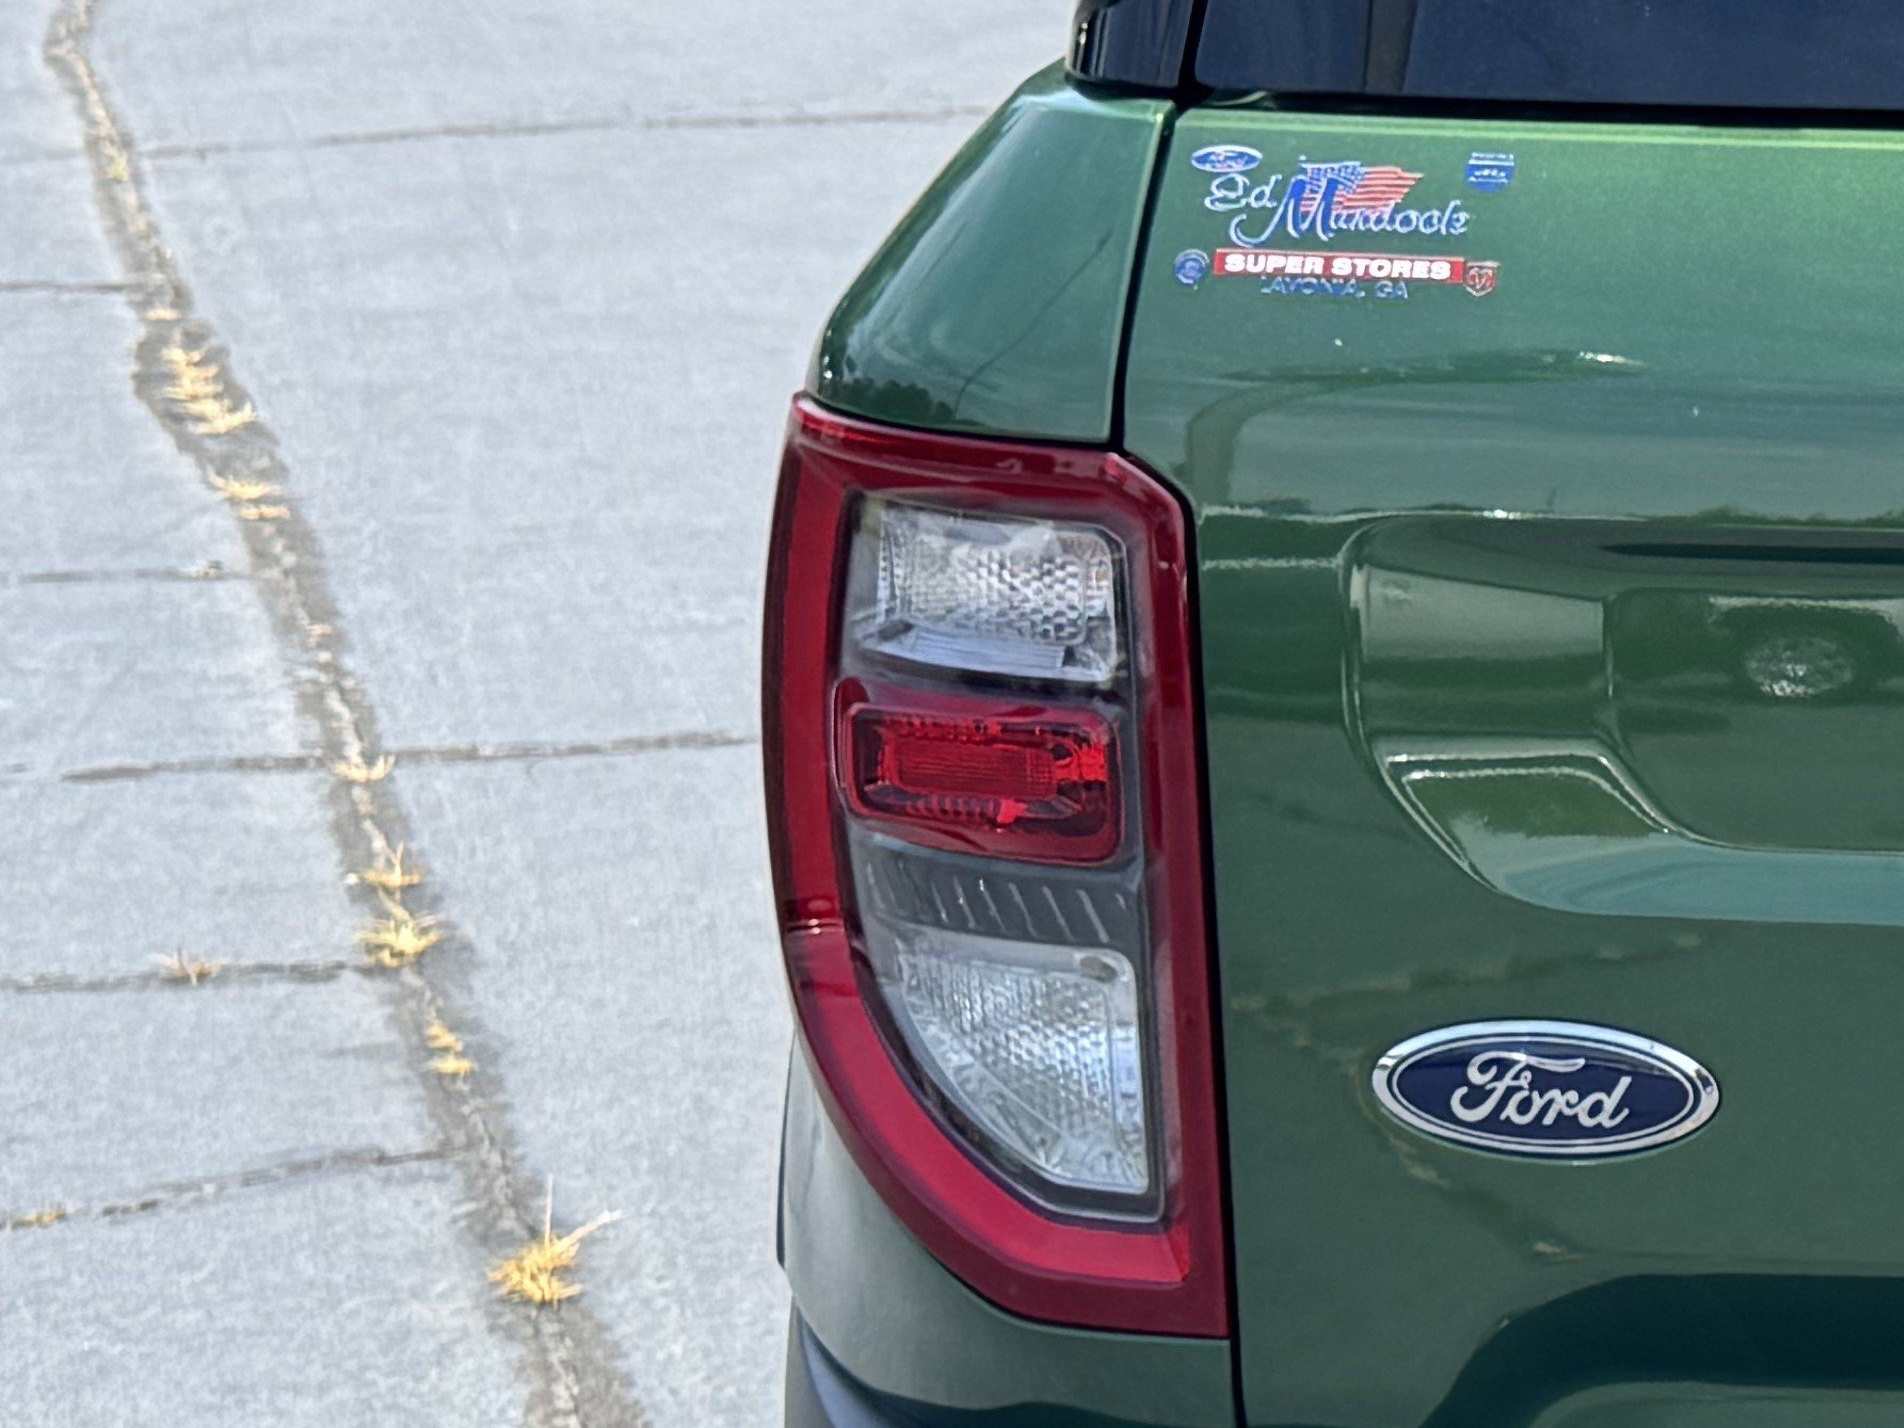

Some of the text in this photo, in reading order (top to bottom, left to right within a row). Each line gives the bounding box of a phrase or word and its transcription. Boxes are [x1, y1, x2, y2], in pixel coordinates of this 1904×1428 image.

[1205, 170, 1471, 248] Ed Murdock
[1223, 253, 1452, 280] SUPER STORES
[1450, 1049, 1632, 1129] Ford
